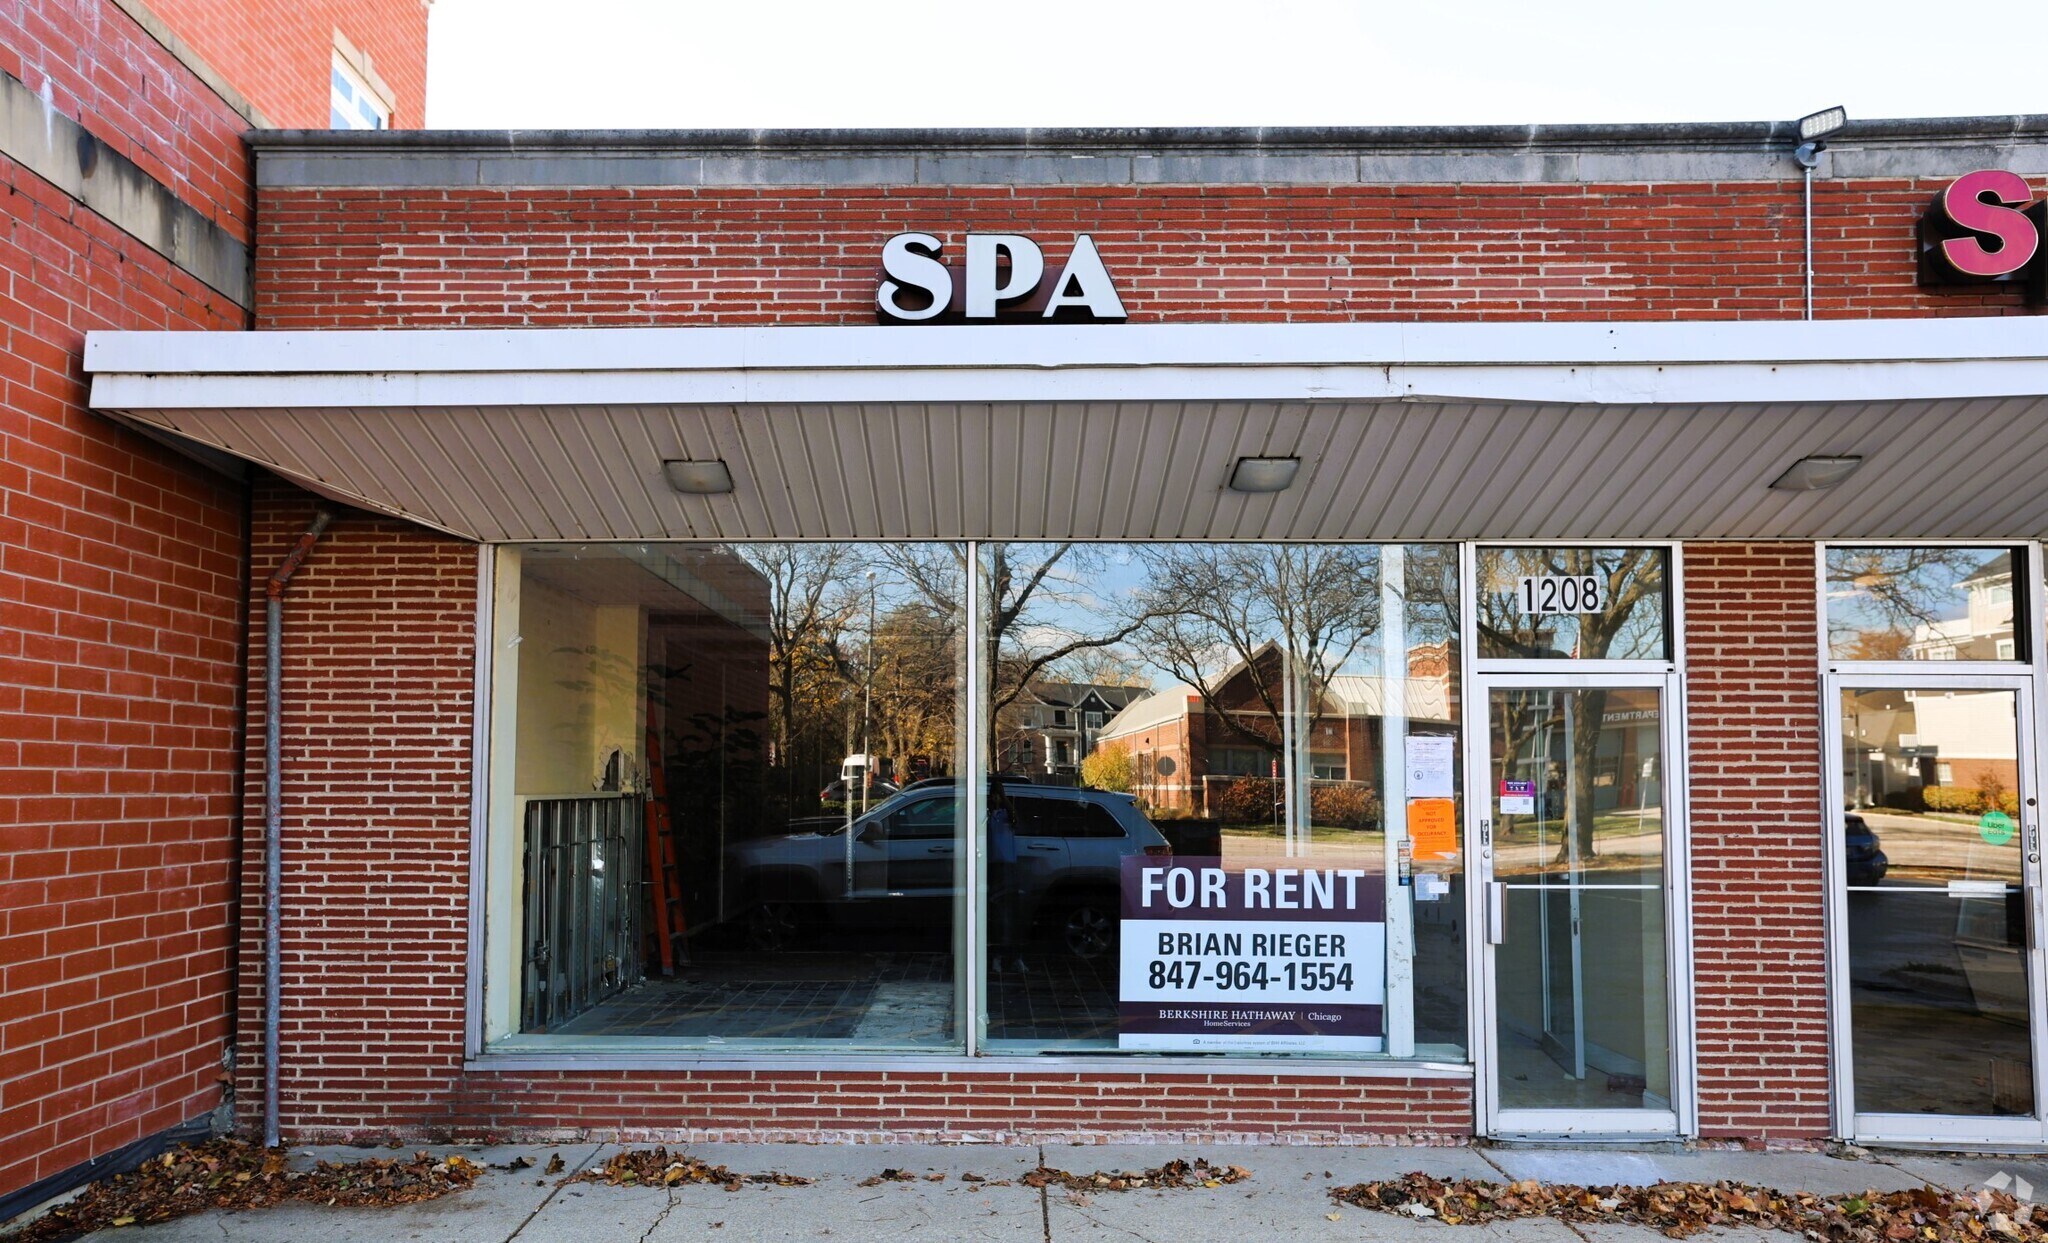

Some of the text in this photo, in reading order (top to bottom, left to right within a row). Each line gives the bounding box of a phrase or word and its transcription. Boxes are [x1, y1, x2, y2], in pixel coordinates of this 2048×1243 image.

[1942, 168, 2048, 276] S
[877, 231, 1129, 322] SPA
[1523, 577, 1599, 612] 1208
[1481, 820, 1489, 845] PULL
[1142, 867, 1365, 910] FOR RENT
[1158, 932, 1346, 957] BRIAN RIEGER
[1149, 960, 1354, 991] 847-964-1554
[1159, 1009, 1342, 1023] BERKSHIRE HATHAWAY Chicago
